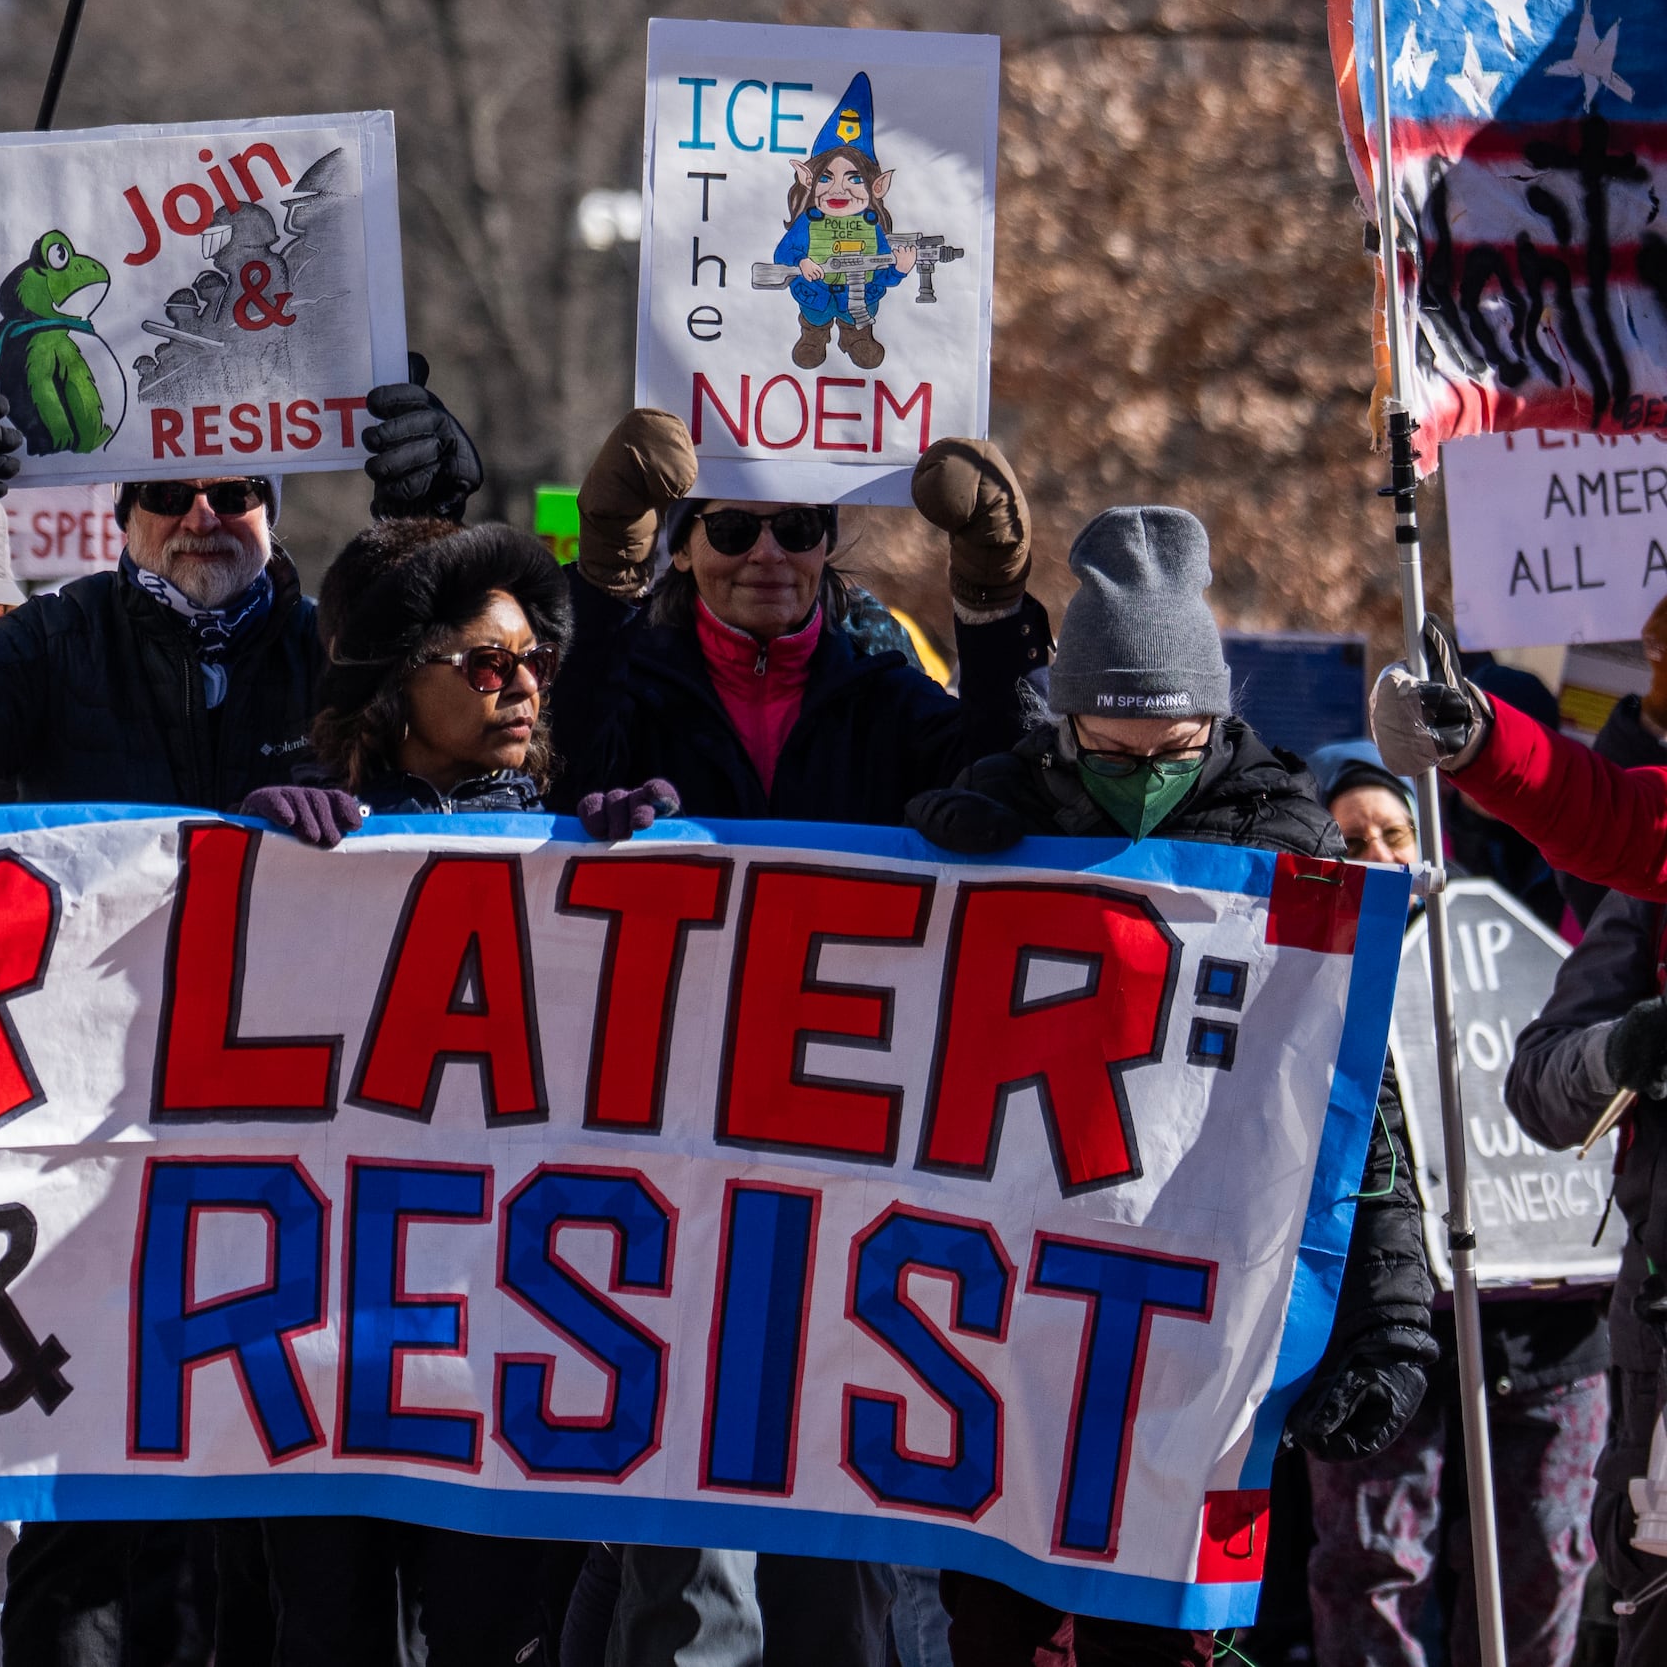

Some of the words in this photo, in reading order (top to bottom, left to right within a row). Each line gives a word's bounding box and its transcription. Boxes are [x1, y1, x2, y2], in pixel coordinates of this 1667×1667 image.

[677, 75, 814, 156] ICE
[122, 141, 294, 267] Join
[824, 218, 864, 231] POLICE
[831, 230, 854, 240] ICE
[232, 260, 298, 332] &
[149, 396, 369, 460] RESIST
[691, 371, 934, 456] NOEM
[30, 508, 126, 562] SPEE
[1508, 543, 1606, 597] ALL
[1097, 694, 1114, 708] I'M
[149, 820, 1249, 1198] LATER:
[1468, 1167, 1609, 1228] ENERGY
[125, 1153, 1219, 1563] RESIST
